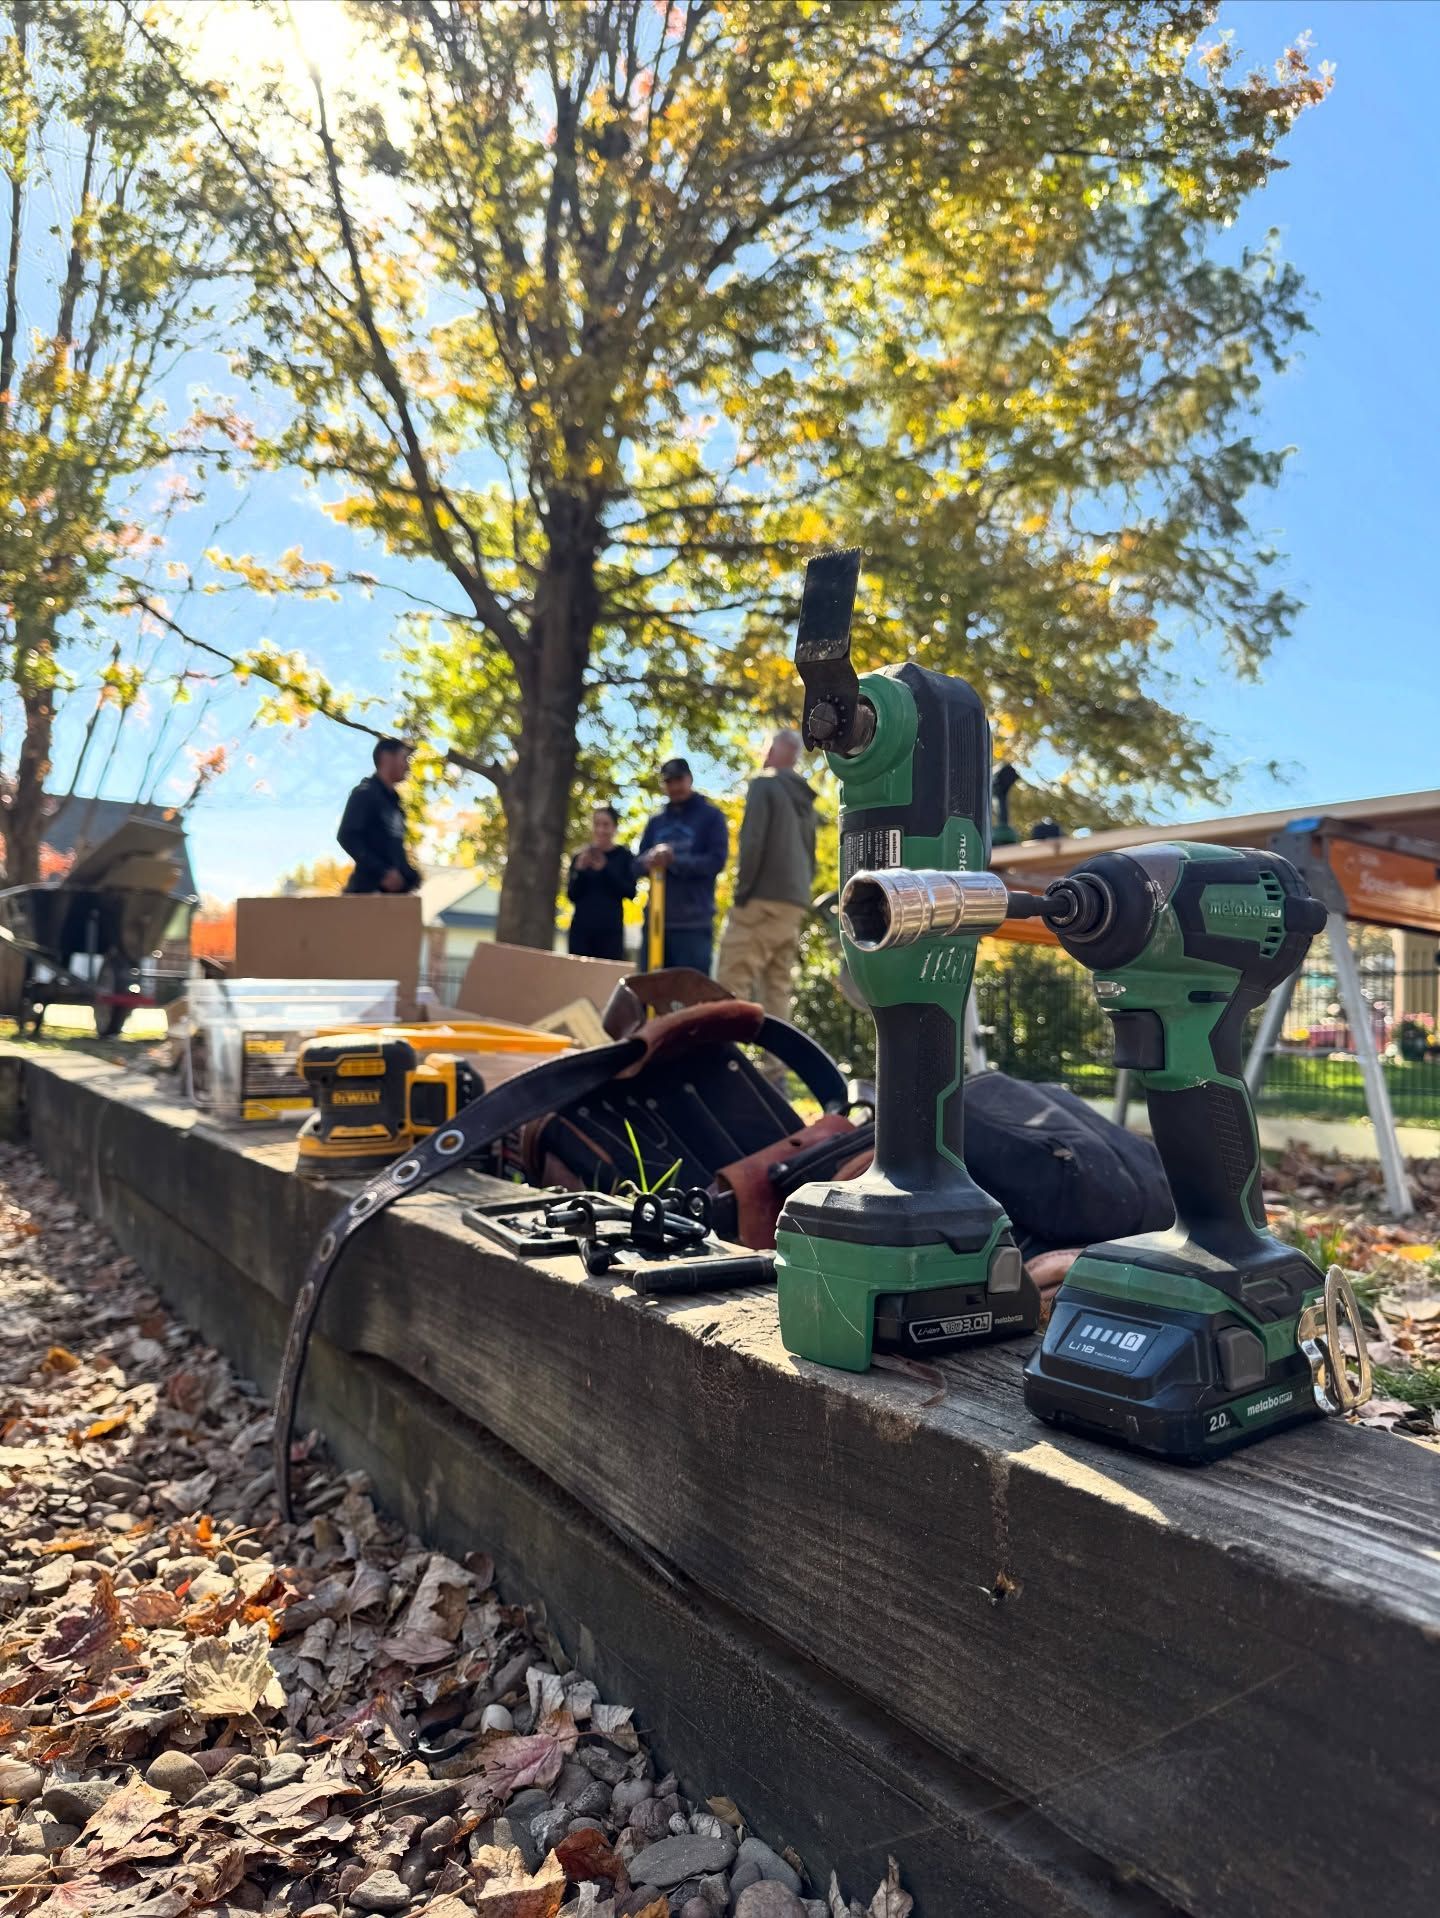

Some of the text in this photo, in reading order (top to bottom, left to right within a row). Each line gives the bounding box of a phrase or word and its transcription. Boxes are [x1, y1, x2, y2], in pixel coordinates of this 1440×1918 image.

[959, 834, 967, 871] meta
[1208, 900, 1260, 915] metabo
[1247, 1396, 1279, 1417] metabo
